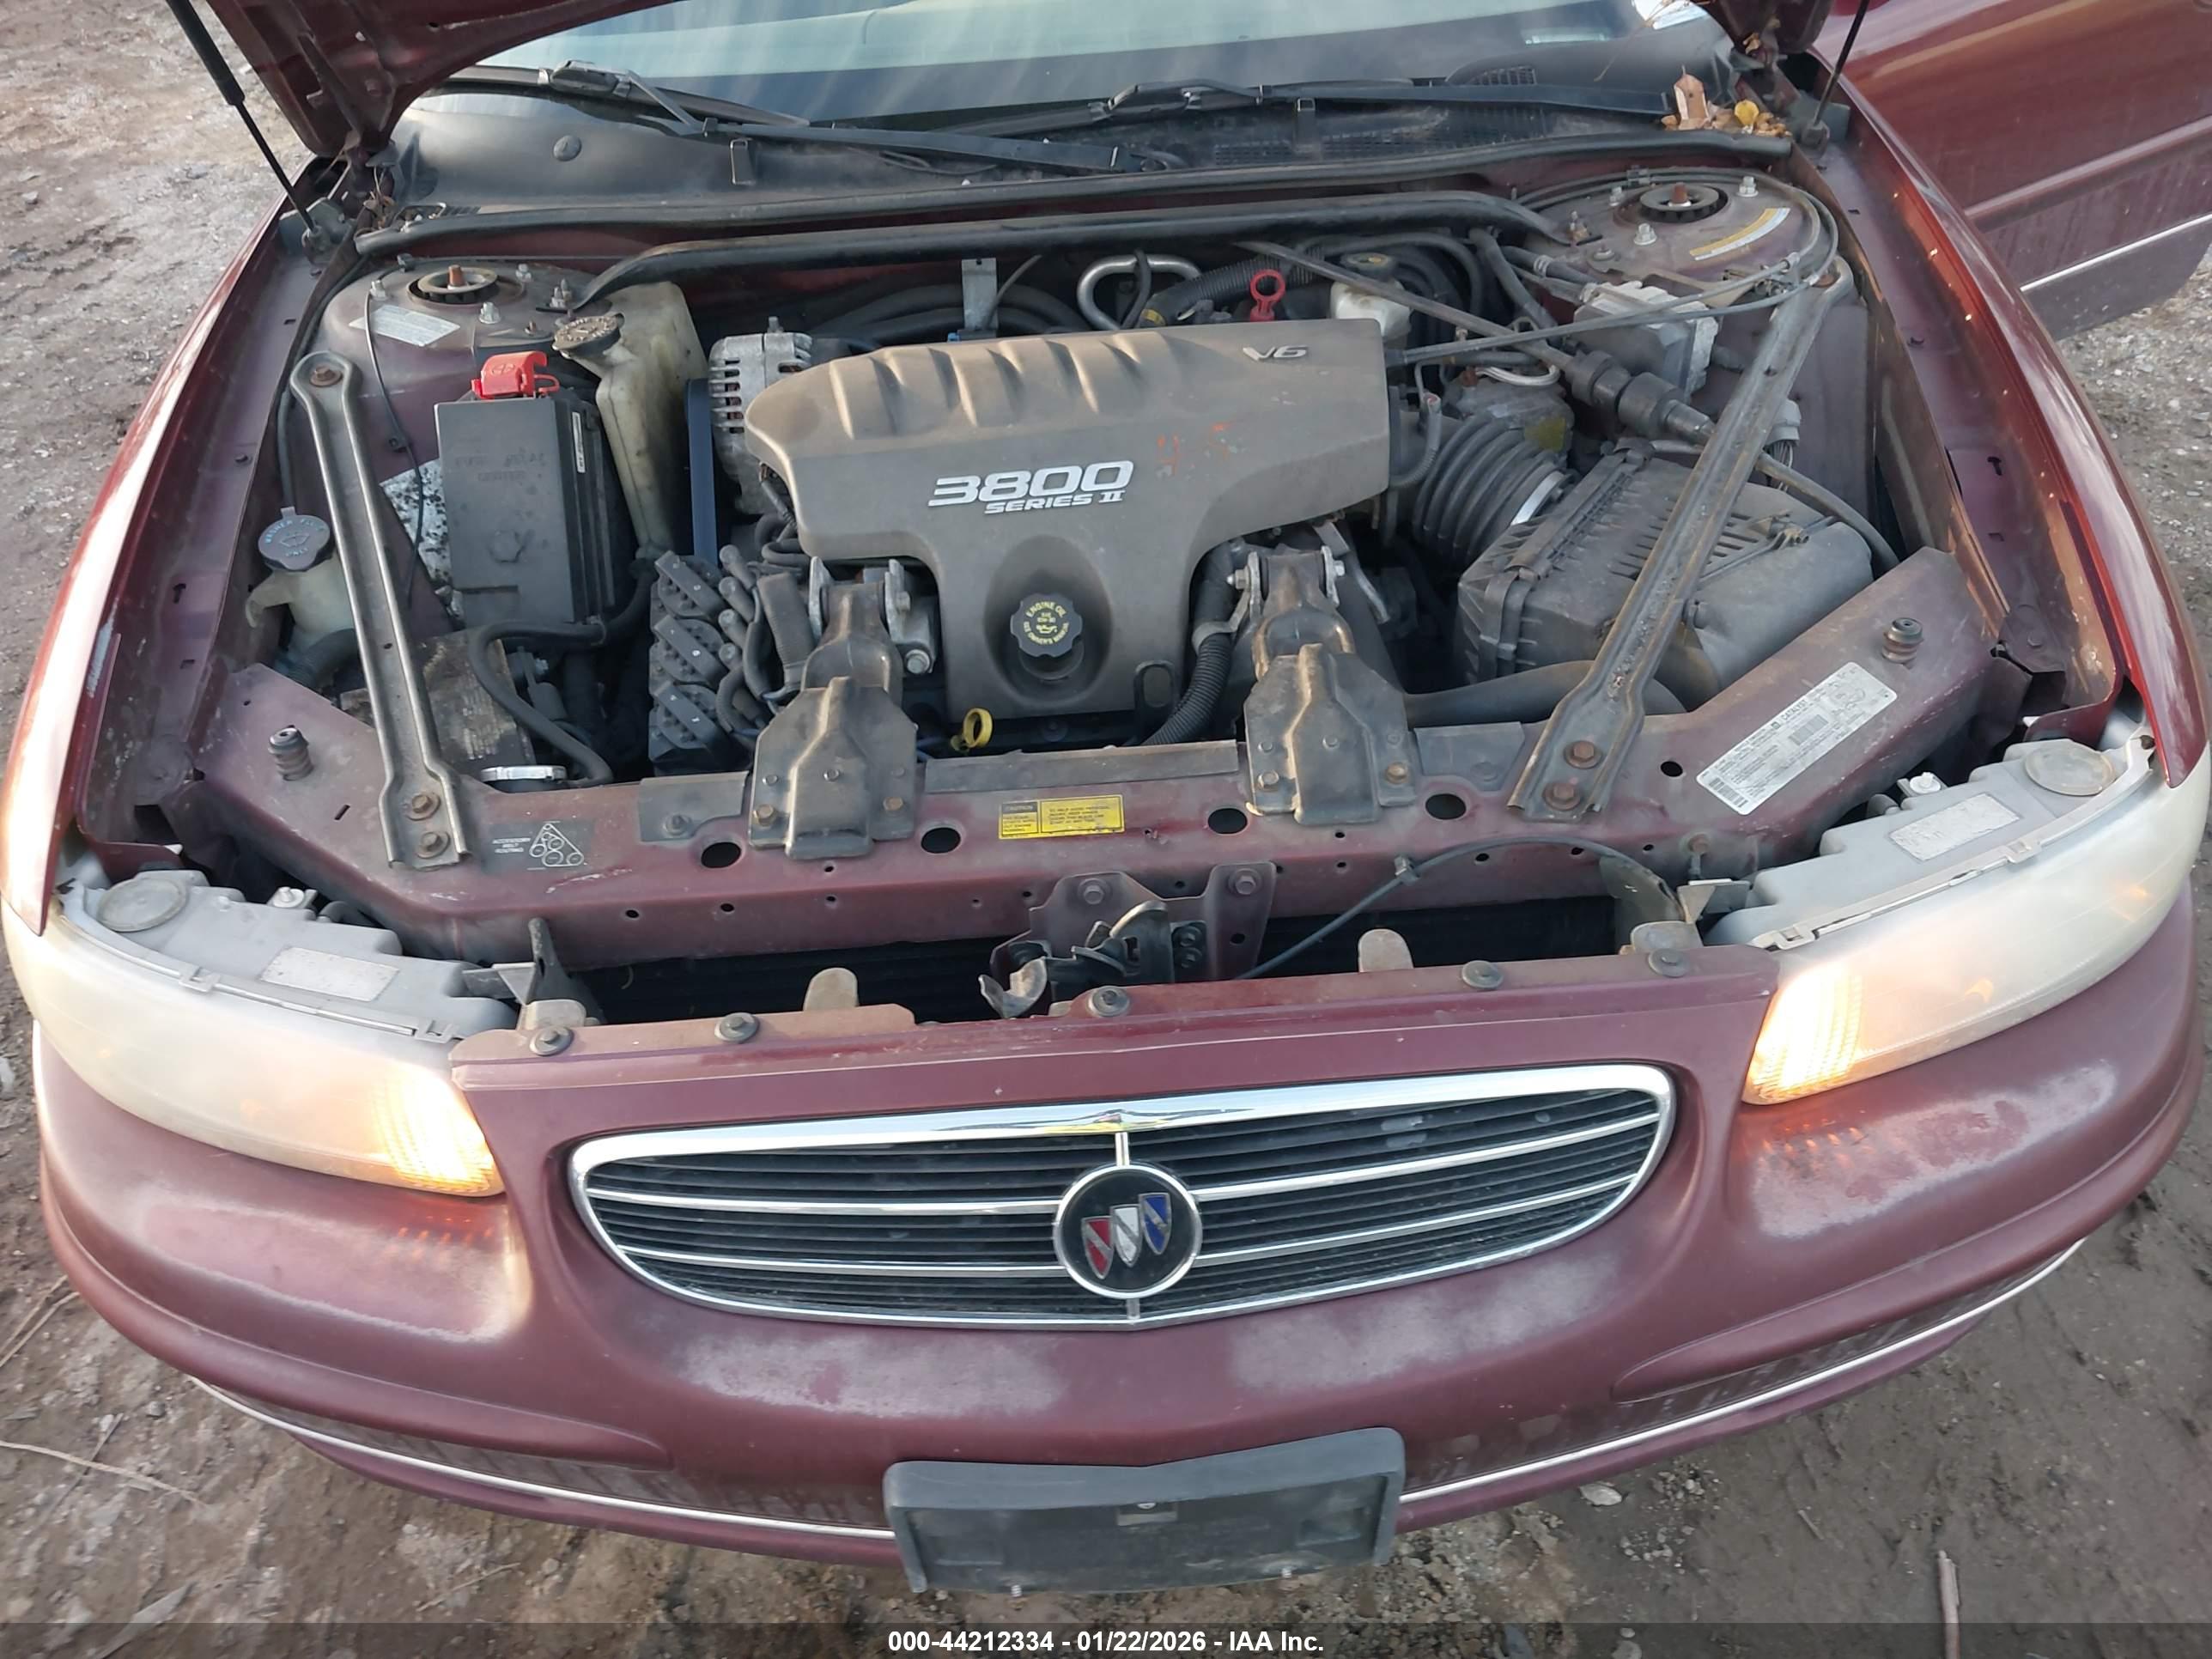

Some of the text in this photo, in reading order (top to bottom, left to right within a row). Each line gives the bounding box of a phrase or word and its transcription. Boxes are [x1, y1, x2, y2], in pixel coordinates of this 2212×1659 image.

[1243, 345, 1307, 361] V6
[928, 460, 1134, 507] 3800
[984, 489, 1126, 514] SERIES II
[1025, 601, 1055, 617] ENGINE
[1055, 605, 1066, 618] OIL
[1781, 699, 1808, 720] CATALYST
